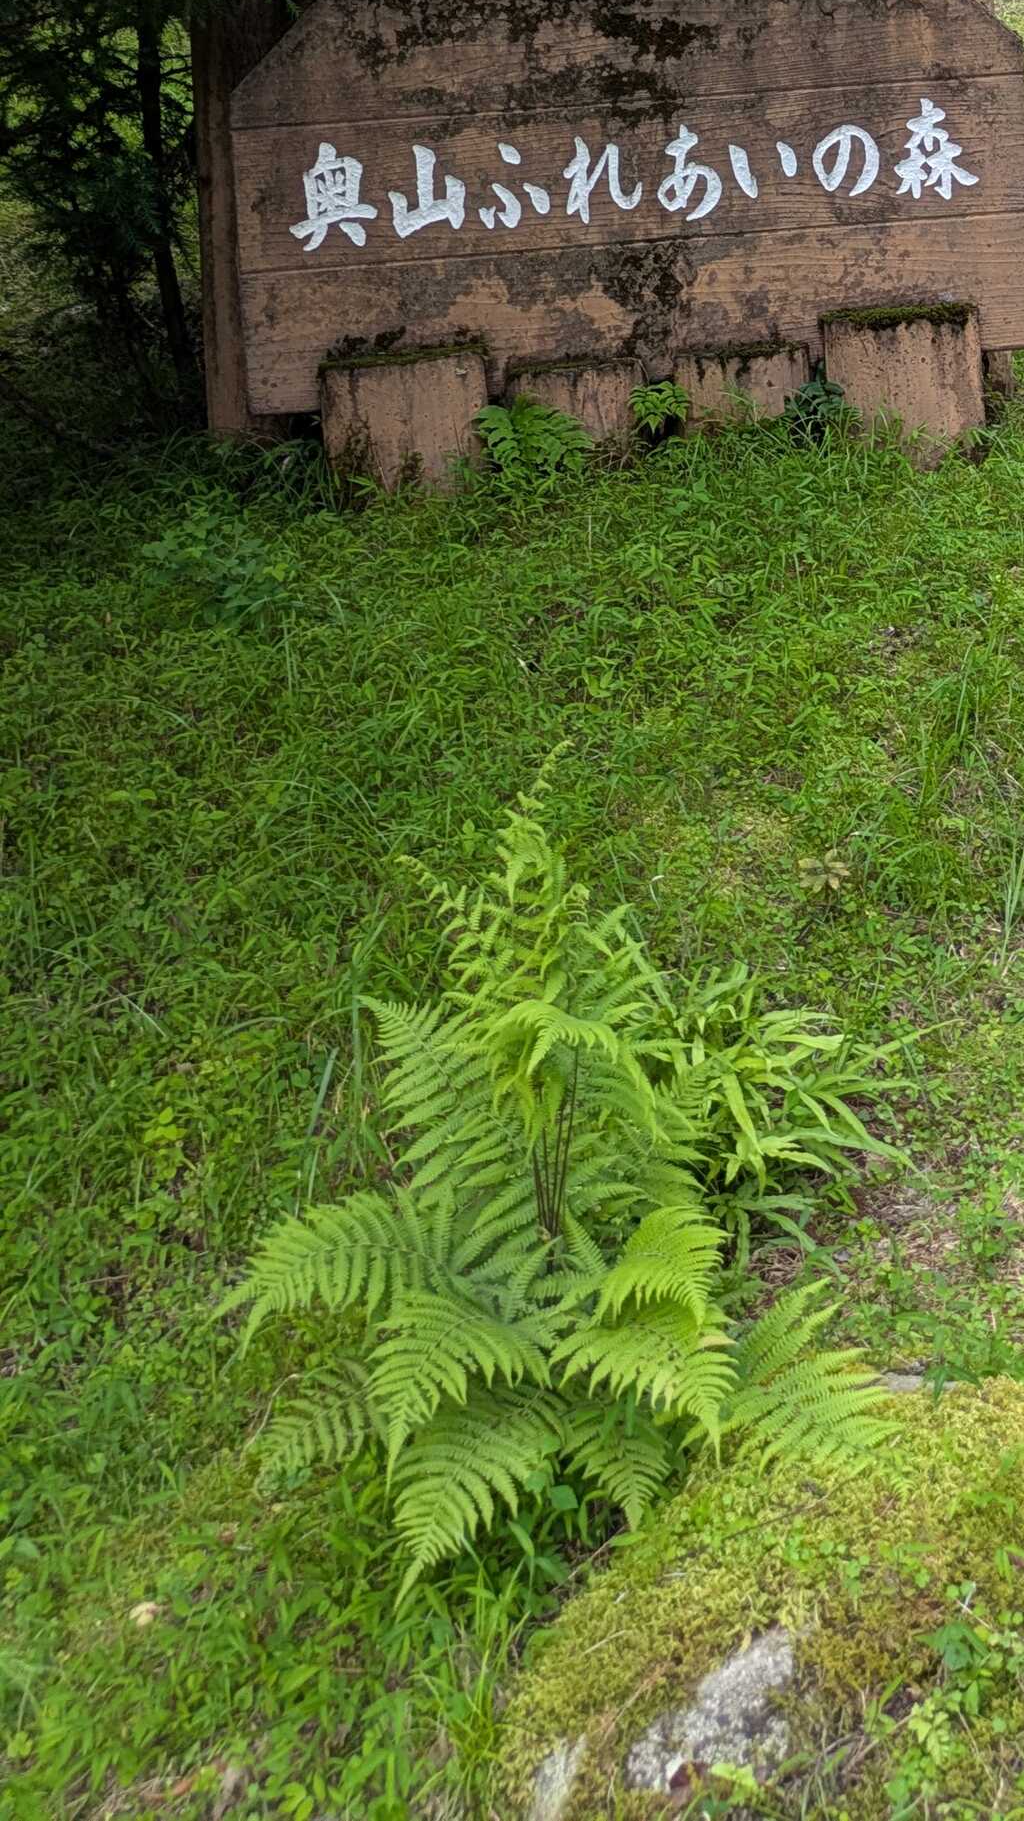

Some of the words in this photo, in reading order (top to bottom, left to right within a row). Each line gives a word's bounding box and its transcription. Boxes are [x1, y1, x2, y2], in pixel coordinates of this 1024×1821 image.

[289, 97, 980, 252] 奥山ふれあいの森
